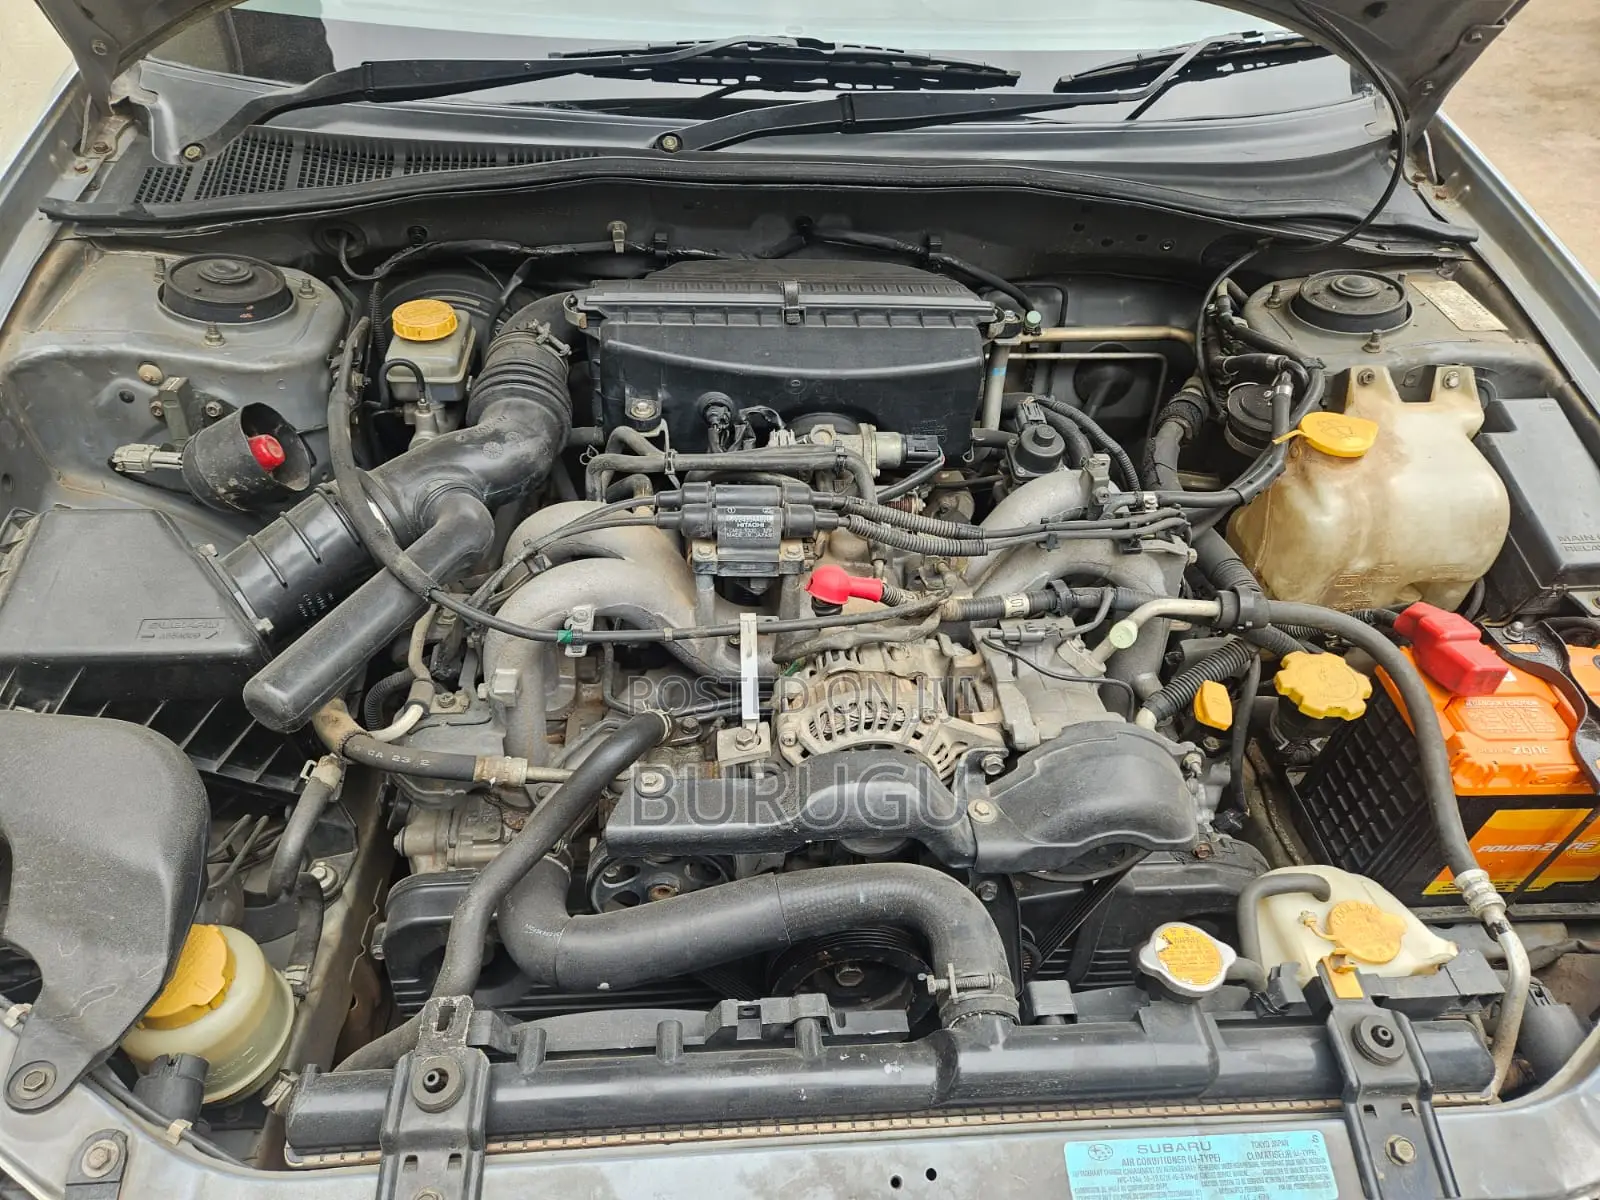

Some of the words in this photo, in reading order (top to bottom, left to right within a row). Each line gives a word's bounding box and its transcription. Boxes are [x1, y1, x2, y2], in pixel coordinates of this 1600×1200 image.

[1311, 1134, 1320, 1144] S
[1137, 1141, 1211, 1154] SUBARU
[1121, 1158, 1136, 1167] AIR
[1136, 1155, 1187, 1166] CONDITIONER
